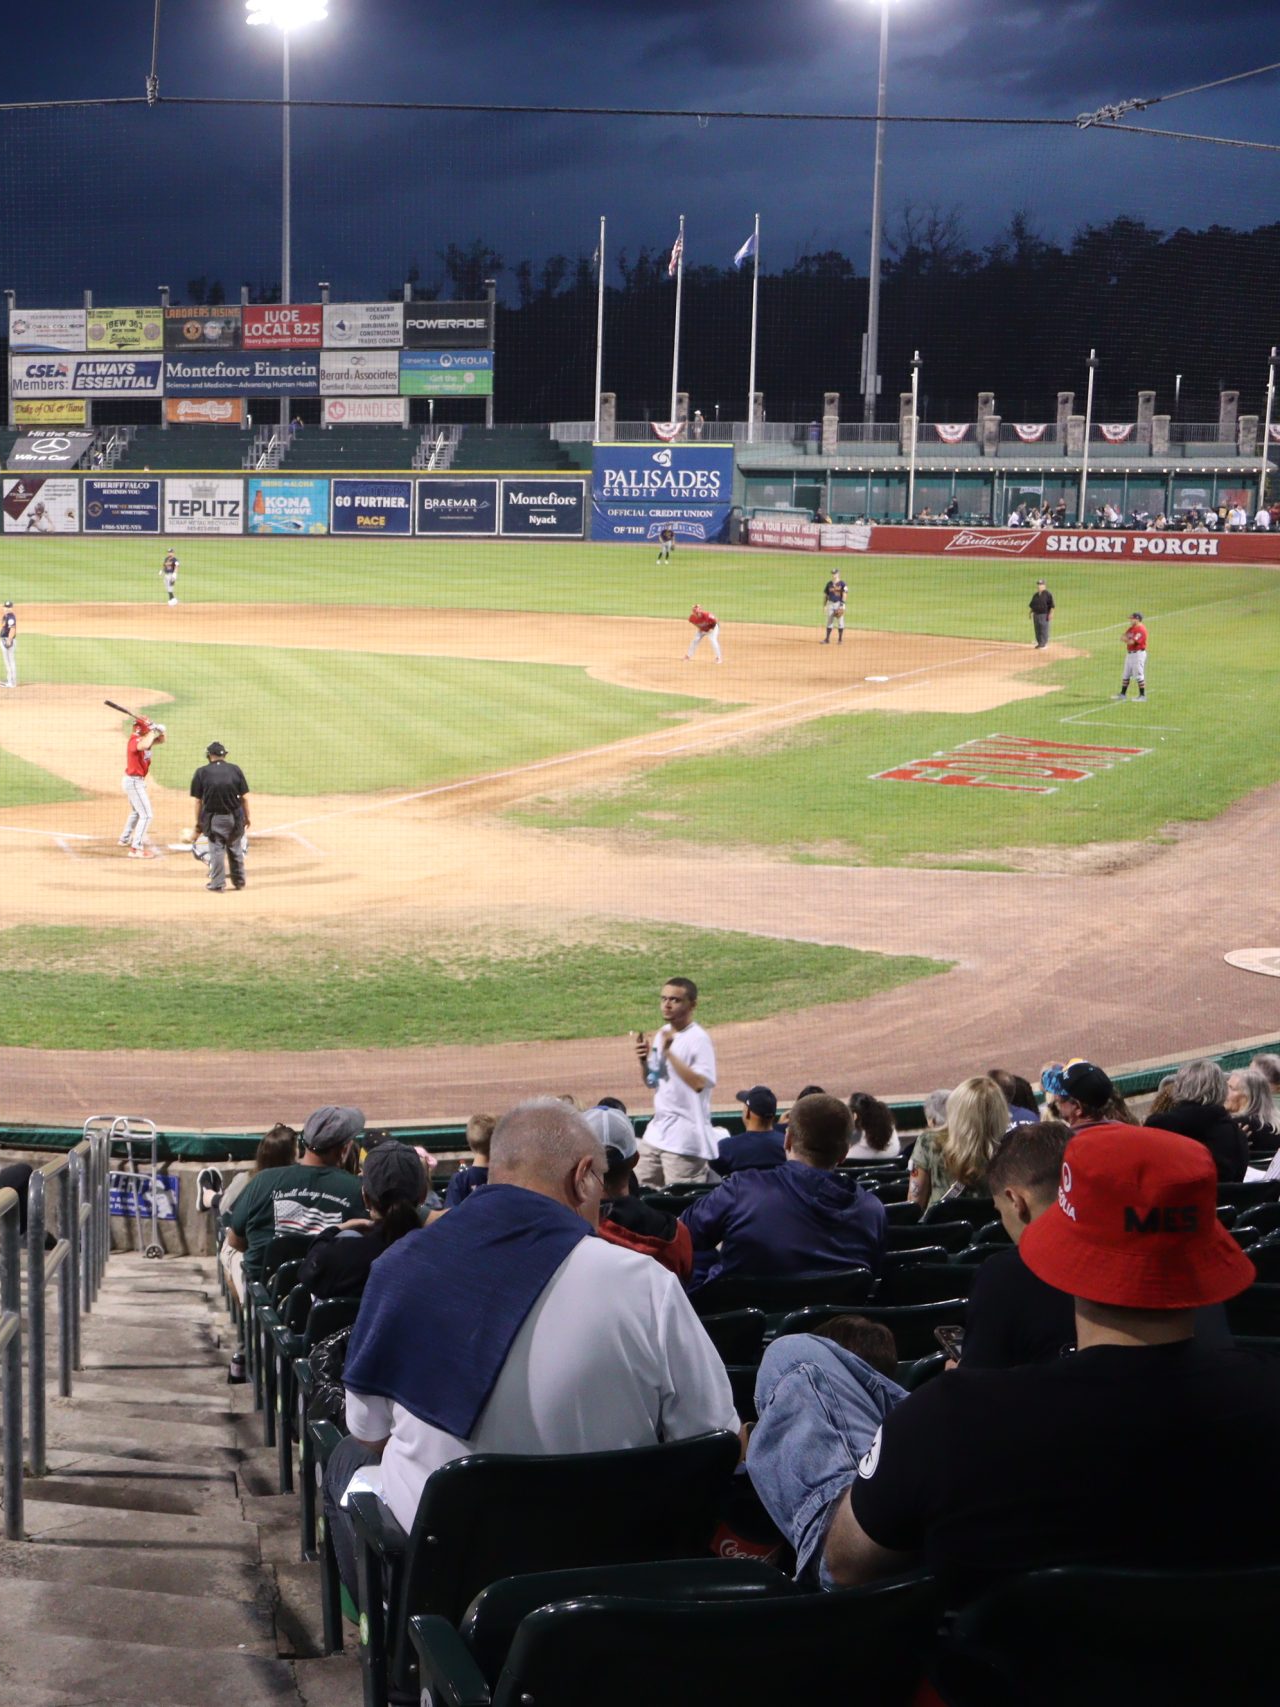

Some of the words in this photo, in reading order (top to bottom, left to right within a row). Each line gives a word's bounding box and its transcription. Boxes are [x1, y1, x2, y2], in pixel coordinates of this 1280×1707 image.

[165, 307, 209, 318] LABORERS
[211, 306, 241, 317] RISING
[264, 310, 300, 322] IUOE
[244, 323, 290, 336] LOCAL
[293, 323, 320, 334] 825
[406, 319, 485, 329] POWERADE
[453, 356, 489, 365] VEOLIA
[25, 364, 67, 378] CSEA
[77, 363, 136, 376] ALWAYS
[166, 362, 250, 377] Montefiore
[254, 361, 317, 376] Einstein
[320, 368, 350, 380] Berard
[354, 368, 398, 380] Associates
[12, 379, 69, 391] Members:
[75, 376, 154, 388] ESSENTIAL
[348, 401, 401, 417] HANDLES
[27, 430, 45, 438] Hit
[47, 430, 65, 438] the
[603, 469, 720, 488] PALISADES
[93, 481, 125, 489] SHERIFF
[125, 481, 150, 489] FALCO
[509, 492, 577, 505] Montefiore
[602, 488, 657, 497] CREDIT
[670, 488, 720, 498] UNION
[168, 499, 240, 516] TEPLITZ
[265, 497, 310, 507] KONA
[335, 496, 351, 507] GO
[354, 496, 409, 508] FURTHER.
[424, 498, 477, 510] BRAEMAR
[265, 507, 282, 515] BIG
[283, 507, 312, 515] WAVE
[607, 508, 648, 517] OFFICIAL
[649, 509, 683, 518] CREDIT
[683, 509, 713, 518] UNION
[356, 515, 386, 526] PACE
[529, 514, 557, 526] Nyack
[613, 526, 627, 534] OF
[628, 526, 645, 534] THE
[956, 533, 1030, 547] Budweiser
[1046, 534, 1125, 552] SHORT
[1132, 537, 1218, 556] PORCH
